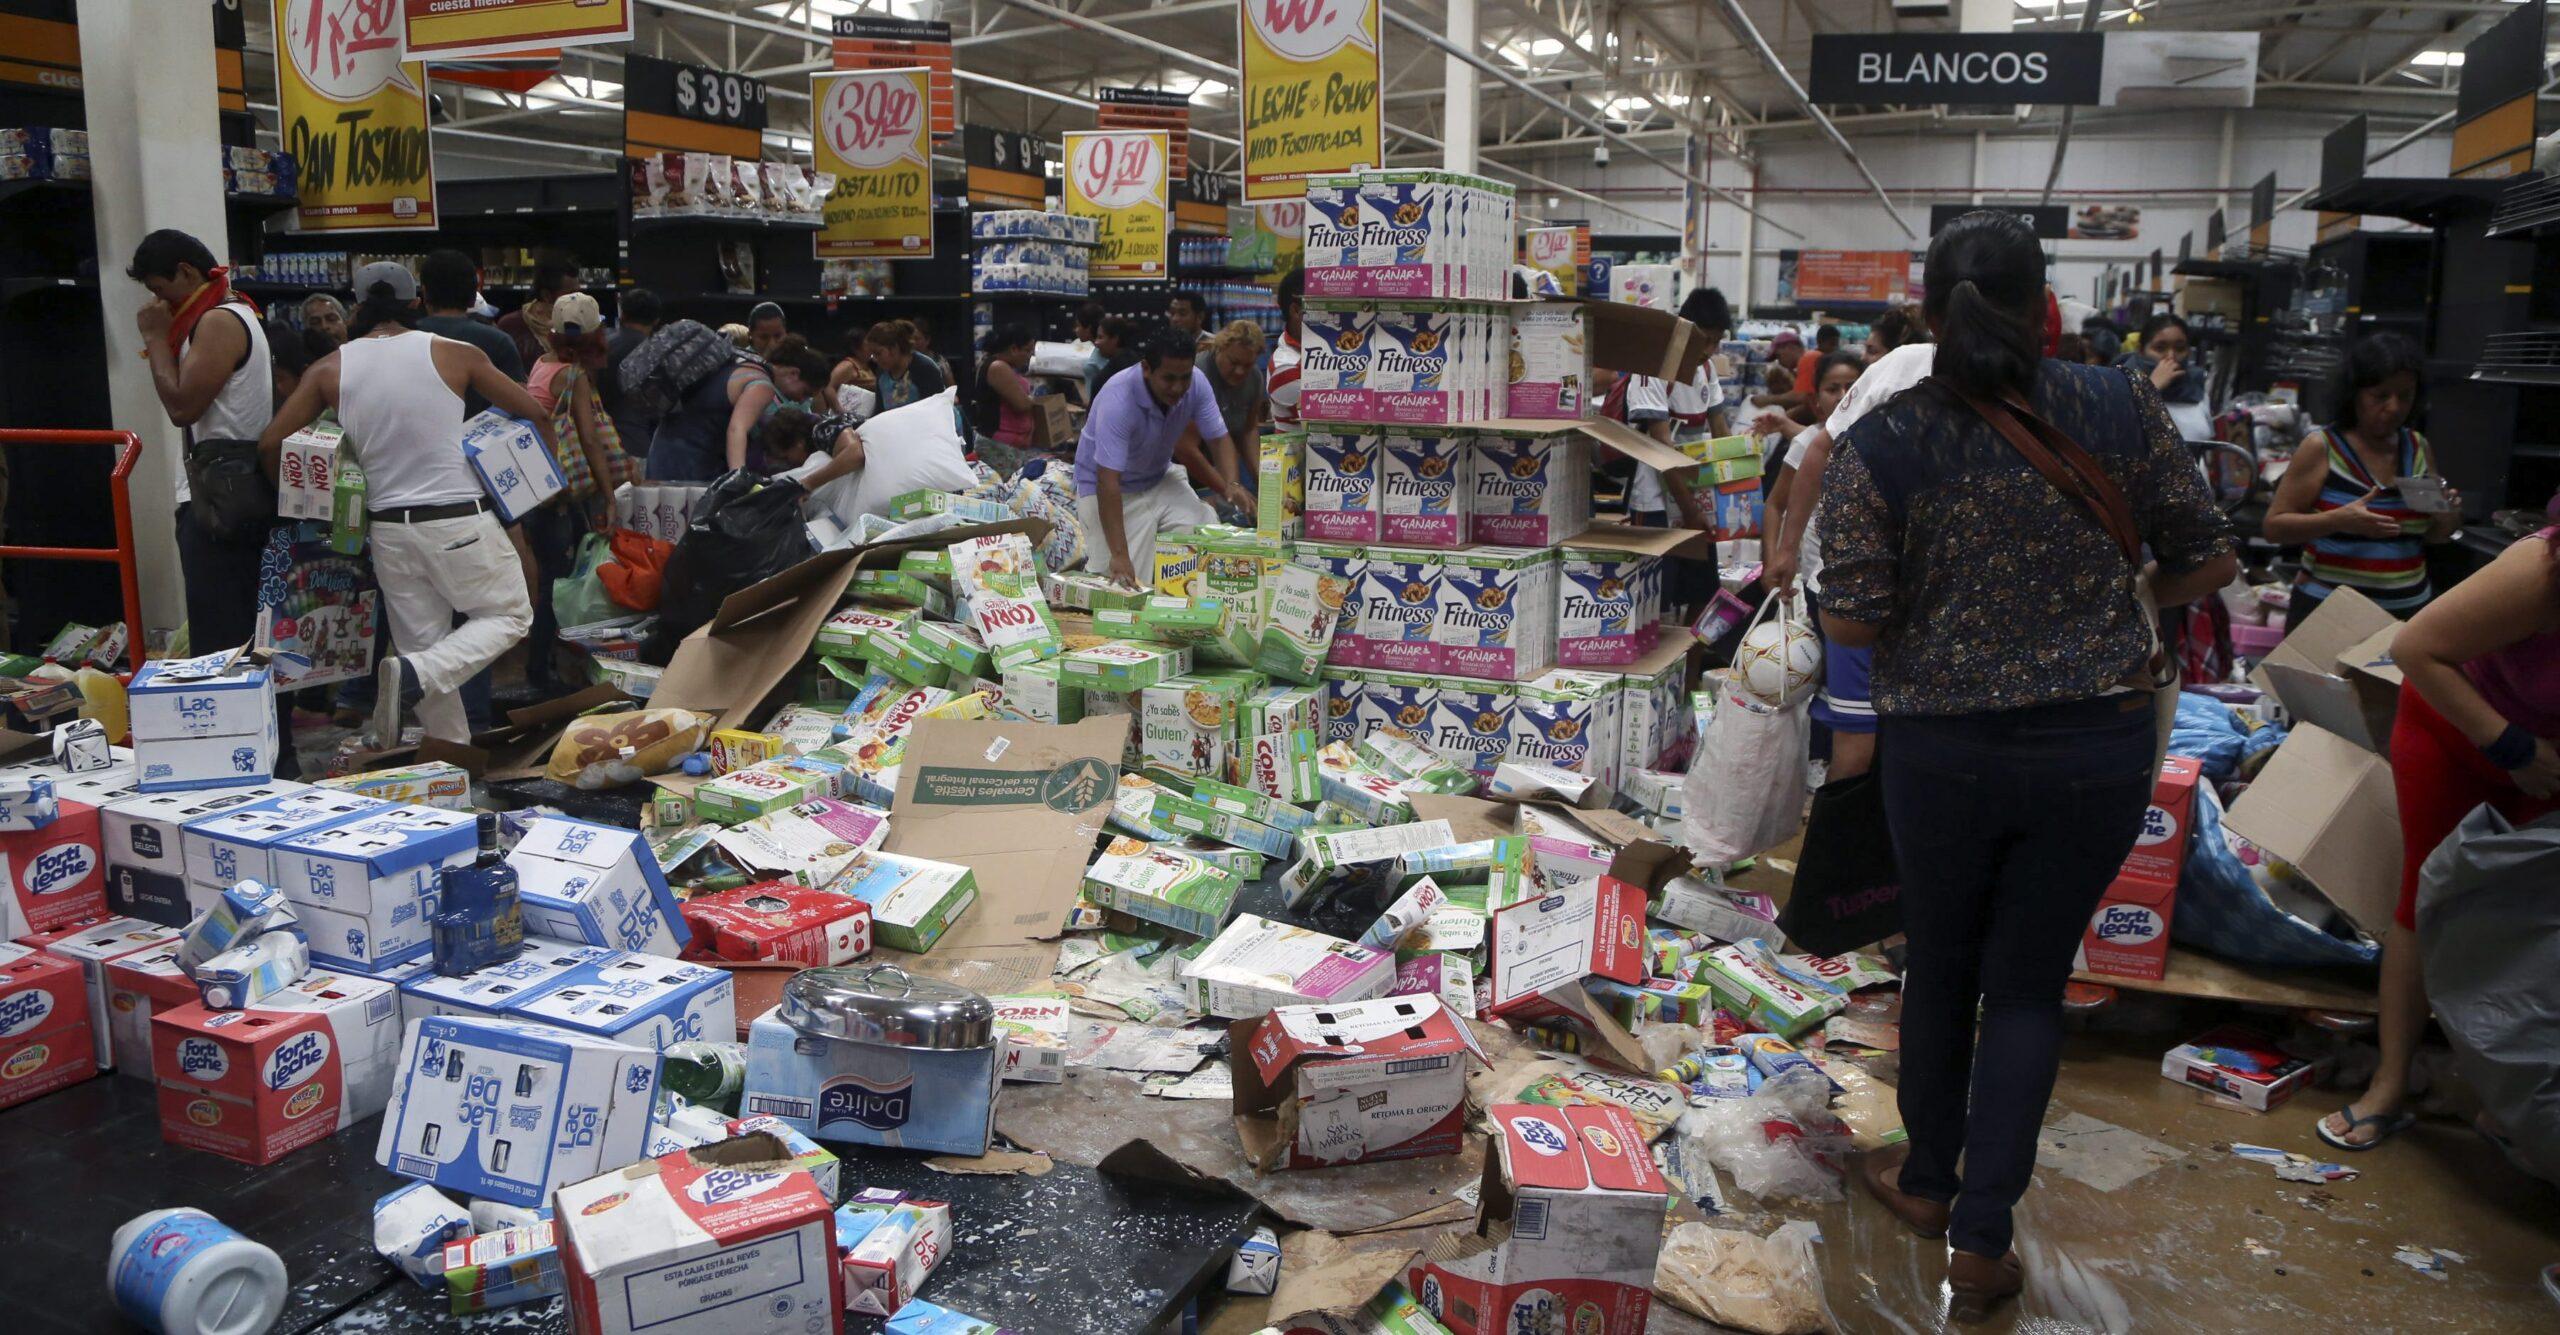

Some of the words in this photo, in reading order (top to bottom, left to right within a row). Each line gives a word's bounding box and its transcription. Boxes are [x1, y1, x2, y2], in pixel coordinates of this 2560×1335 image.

[430, 0, 471, 12] cuesta
[834, 20, 854, 33] 10
[1858, 53, 2048, 83] BLANCOS
[1100, 89, 1116, 99] 11
[1248, 80, 1311, 129] LECHE
[1322, 72, 1376, 117] POLVO
[291, 115, 337, 194] PAN
[336, 110, 429, 191] TOSTADO
[1248, 141, 1277, 163] NIDO
[1277, 125, 1364, 158] FORTIFICADA
[1261, 174, 1287, 182] cuesta
[304, 206, 330, 216] cuesta
[332, 204, 358, 214] menos
[1308, 223, 1359, 248] Fitnes
[1361, 221, 1427, 246] Fitness
[1321, 270, 1358, 282] GANAR
[1375, 268, 1415, 281] GANAR
[1304, 347, 1369, 372] Fitness
[1377, 348, 1443, 373] Fitness
[1318, 394, 1357, 405] GANAR
[1392, 396, 1431, 407] GANAR
[285, 452, 305, 489] CORN
[310, 455, 330, 491] CORN
[1308, 468, 1372, 495] Fitness
[1386, 471, 1453, 499] Fitness
[1476, 471, 1543, 498] Fitness
[1321, 514, 1361, 527] GANAR
[1400, 517, 1440, 530] GANAR
[1491, 517, 1530, 530] GANAR
[1161, 553, 1198, 580] Nesqui
[831, 614, 894, 628] CORN
[979, 604, 1036, 634] CORN
[1275, 600, 1313, 620] Gluten?
[1368, 597, 1435, 624] Fitness
[1444, 602, 1510, 631] Fitness
[1564, 595, 1631, 622] Fitness
[1383, 641, 1422, 653] GANAR
[1457, 648, 1498, 662] GANAR
[1577, 640, 1619, 652] GANAR
[178, 696, 216, 713] Lac
[888, 691, 927, 733] CORN
[1146, 702, 1163, 718] ¿Yo
[1146, 722, 1188, 743] Gluten?
[1438, 726, 1507, 754] Fitness
[1516, 733, 1585, 761] Fitness
[726, 772, 788, 790] CORN
[969, 775, 1002, 786] Cereal
[1257, 740, 1282, 799] CORN
[979, 786, 1035, 796] Cereales
[556, 838, 588, 854] Del
[565, 826, 597, 841] Lac
[134, 841, 161, 854] SELECTA
[211, 843, 237, 864] Lac
[36, 845, 81, 876] Forti
[215, 861, 237, 881] Del
[307, 858, 334, 879] Lac
[32, 859, 89, 896] Leche
[310, 877, 335, 898] Del
[416, 869, 443, 897] La
[1419, 884, 1437, 915] CORN
[632, 889, 658, 938] Lac
[2105, 907, 2150, 925] Forti
[618, 911, 646, 952] Del
[2097, 921, 2153, 939] Leche
[486, 961, 530, 977] Lac
[507, 964, 546, 981] Del
[1729, 954, 1804, 1002] CORN
[593, 977, 640, 997] Lac
[616, 981, 658, 1001] Del
[0, 1003, 47, 1036] eche
[655, 1012, 702, 1055] Lac
[186, 1040, 218, 1059] Forti
[275, 1033, 316, 1070] Forti
[183, 1055, 223, 1073] Leche
[271, 1050, 324, 1093] Leche
[464, 1075, 502, 1107] Del
[1572, 1074, 1660, 1113] FLAKES
[1579, 1071, 1673, 1106] CORN
[459, 1102, 499, 1136] Lac
[1371, 1108, 1405, 1120] RETOMA
[1406, 1108, 1415, 1117] EL
[1416, 1104, 1449, 1115] ORIGEN
[558, 1104, 582, 1150] Lac
[575, 1107, 599, 1147] Del
[1319, 1128, 1363, 1150] MARCOS
[1326, 1124, 1348, 1138] SAN
[713, 1224, 739, 1235] Cont.
[741, 1220, 750, 1229] 12
[752, 1210, 792, 1225] Envases
[793, 1206, 804, 1214] de
[912, 1242, 932, 1271] Del
[921, 1230, 940, 1263] Lac
[664, 1271, 684, 1282] ESTA
[684, 1265, 705, 1277] CAJA
[705, 1259, 726, 1271] ESTÁ
[725, 1257, 736, 1266] AL
[737, 1250, 760, 1263] REVÉS
[678, 1274, 714, 1289] PÓNGASE
[714, 1263, 749, 1279] DERECHA
[699, 1289, 733, 1304] GRACIAS
